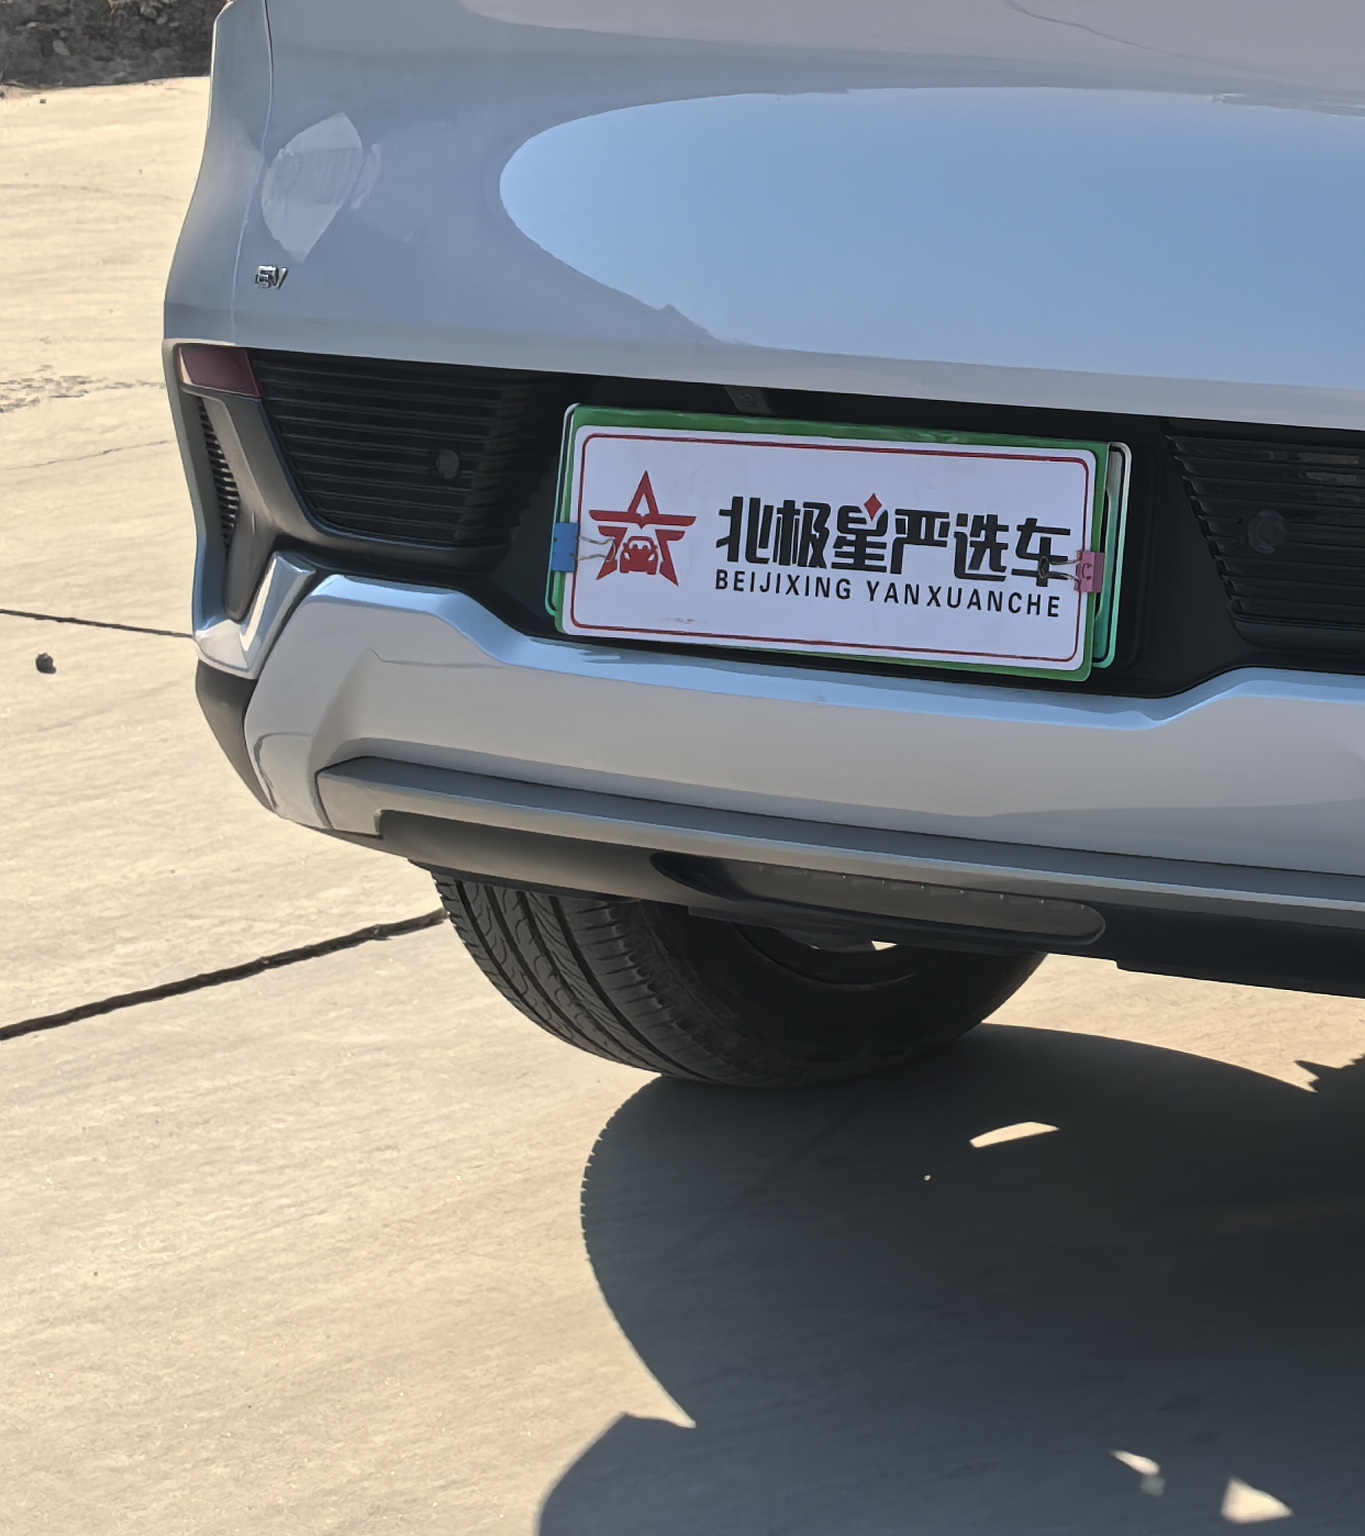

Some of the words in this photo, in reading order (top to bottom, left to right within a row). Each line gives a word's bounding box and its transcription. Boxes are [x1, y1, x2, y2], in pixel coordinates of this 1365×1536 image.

[715, 492, 1071, 587] 北极星严选车
[715, 568, 852, 600] BEIJIXING
[866, 579, 1062, 618] YANXUANCHE
